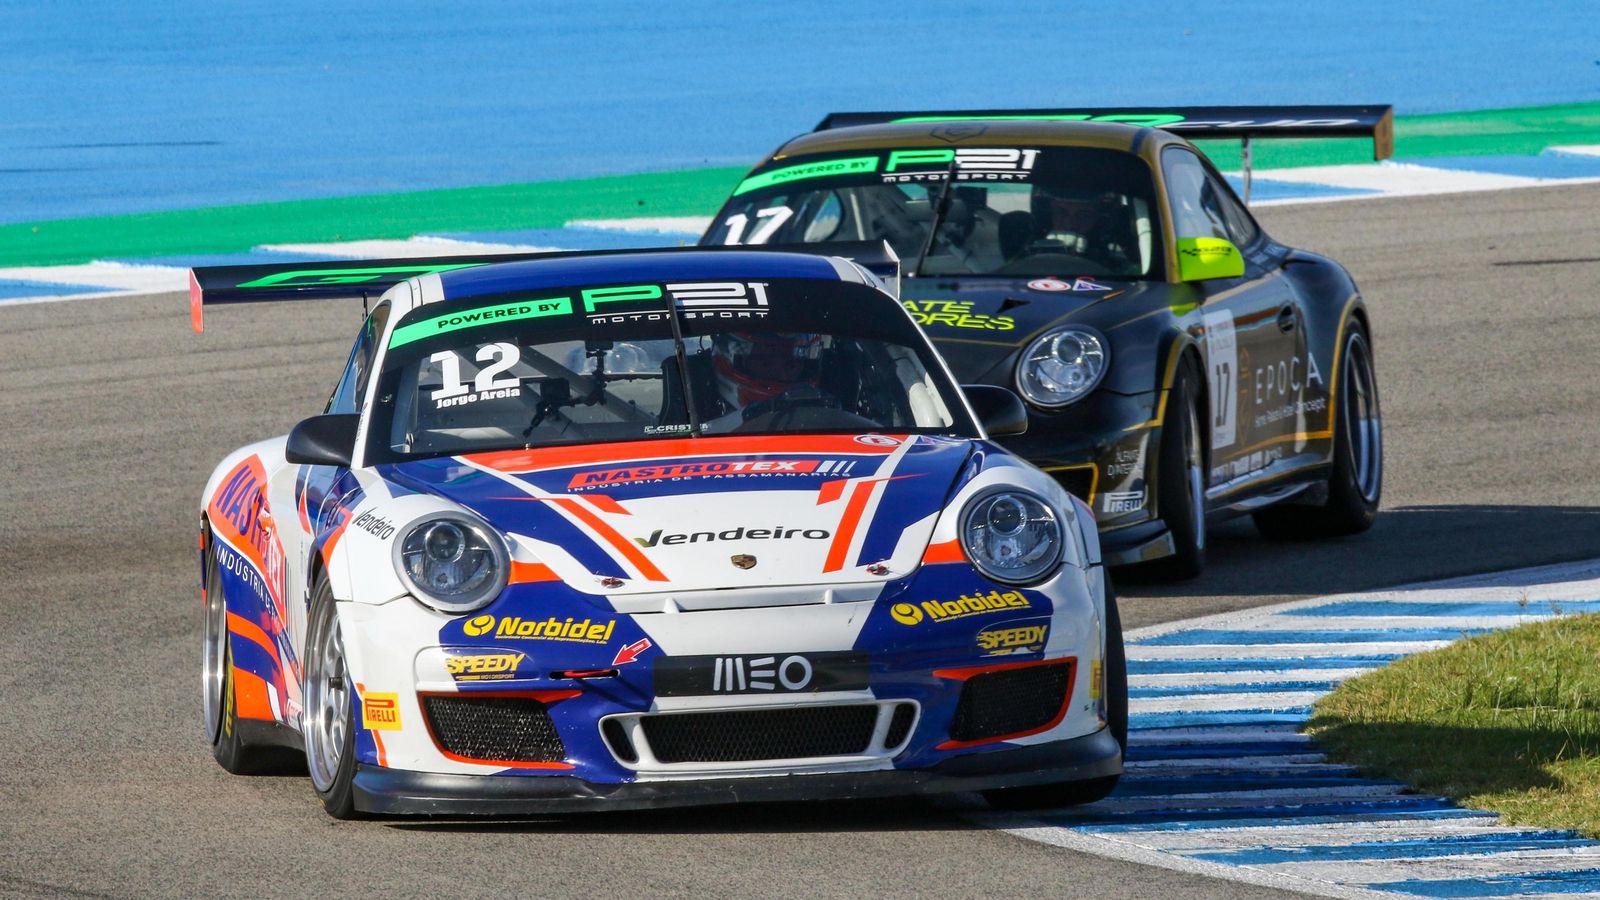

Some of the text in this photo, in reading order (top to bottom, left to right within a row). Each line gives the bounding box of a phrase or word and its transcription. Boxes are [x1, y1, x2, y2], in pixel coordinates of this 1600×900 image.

[772, 163, 845, 181] POWERED
[851, 161, 869, 169] BY
[725, 206, 793, 245] 17
[438, 282, 769, 329] POWERED BY P21
[430, 342, 520, 400] 12
[1256, 352, 1323, 404] EPOCA
[436, 394, 477, 408] Jorge
[1215, 362, 1231, 428] 17
[584, 460, 801, 484] NASTROTEX
[703, 472, 852, 481] PASSAMANARIAS
[352, 506, 396, 540] Vendeiro
[634, 526, 830, 548] Vendeiro
[217, 545, 264, 597] INDÚSTRIA
[921, 590, 1030, 619] Norbidel
[496, 616, 616, 641] Norbidel
[979, 625, 1048, 649] SPEEDY
[445, 653, 525, 674] SPEEDY
[713, 655, 812, 691] MEO
[365, 698, 396, 722] PIRELLI
